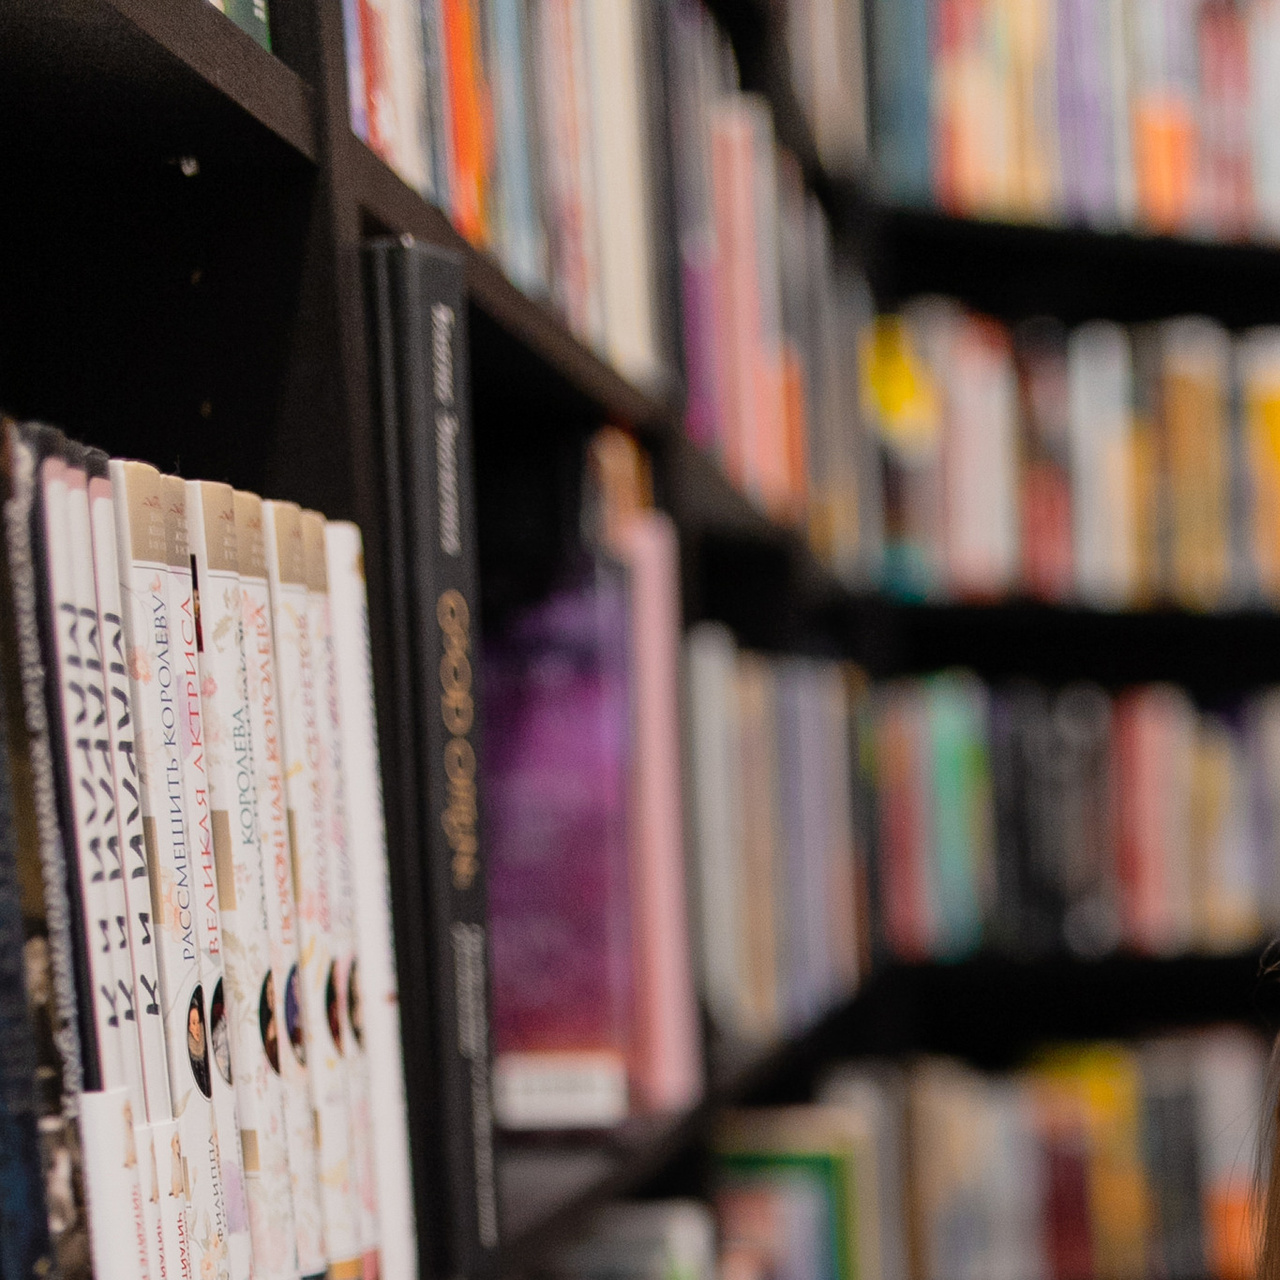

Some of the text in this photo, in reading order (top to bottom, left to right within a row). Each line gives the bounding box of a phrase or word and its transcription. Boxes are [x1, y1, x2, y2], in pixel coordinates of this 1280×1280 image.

[103, 612, 147, 880] МАРЛИ
[152, 594, 195, 962] РАССМЕШИТЬ КОРОЛЕВУ
[180, 596, 219, 956] ВЕЛИКАЯ АКТРИСА
[231, 707, 255, 846] КОРОЛЕВА
[208, 1134, 224, 1243] ФИЛИППА
